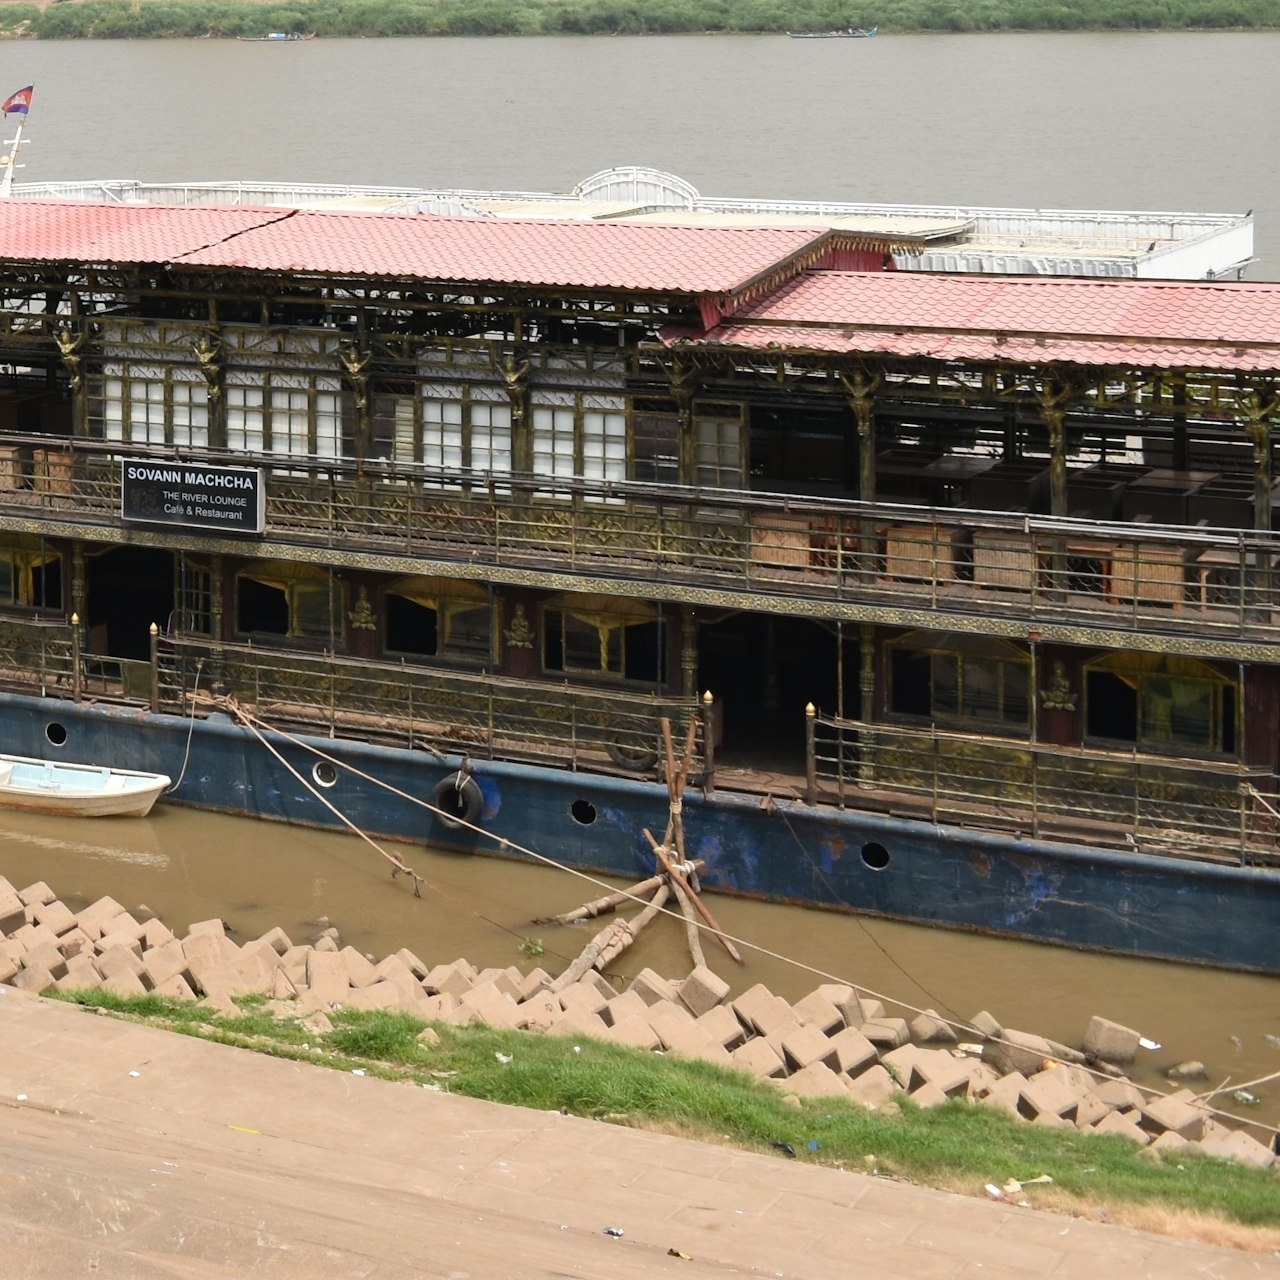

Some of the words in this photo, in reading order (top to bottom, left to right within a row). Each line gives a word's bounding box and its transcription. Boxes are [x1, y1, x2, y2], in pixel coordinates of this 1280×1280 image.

[127, 467, 181, 484] SOVANN
[184, 472, 254, 490] MACHCHA
[162, 491, 180, 500] THE
[181, 493, 208, 503] RIVER
[209, 495, 247, 507] LOUNGE
[186, 507, 193, 515] &
[195, 507, 243, 520] Restaurant
